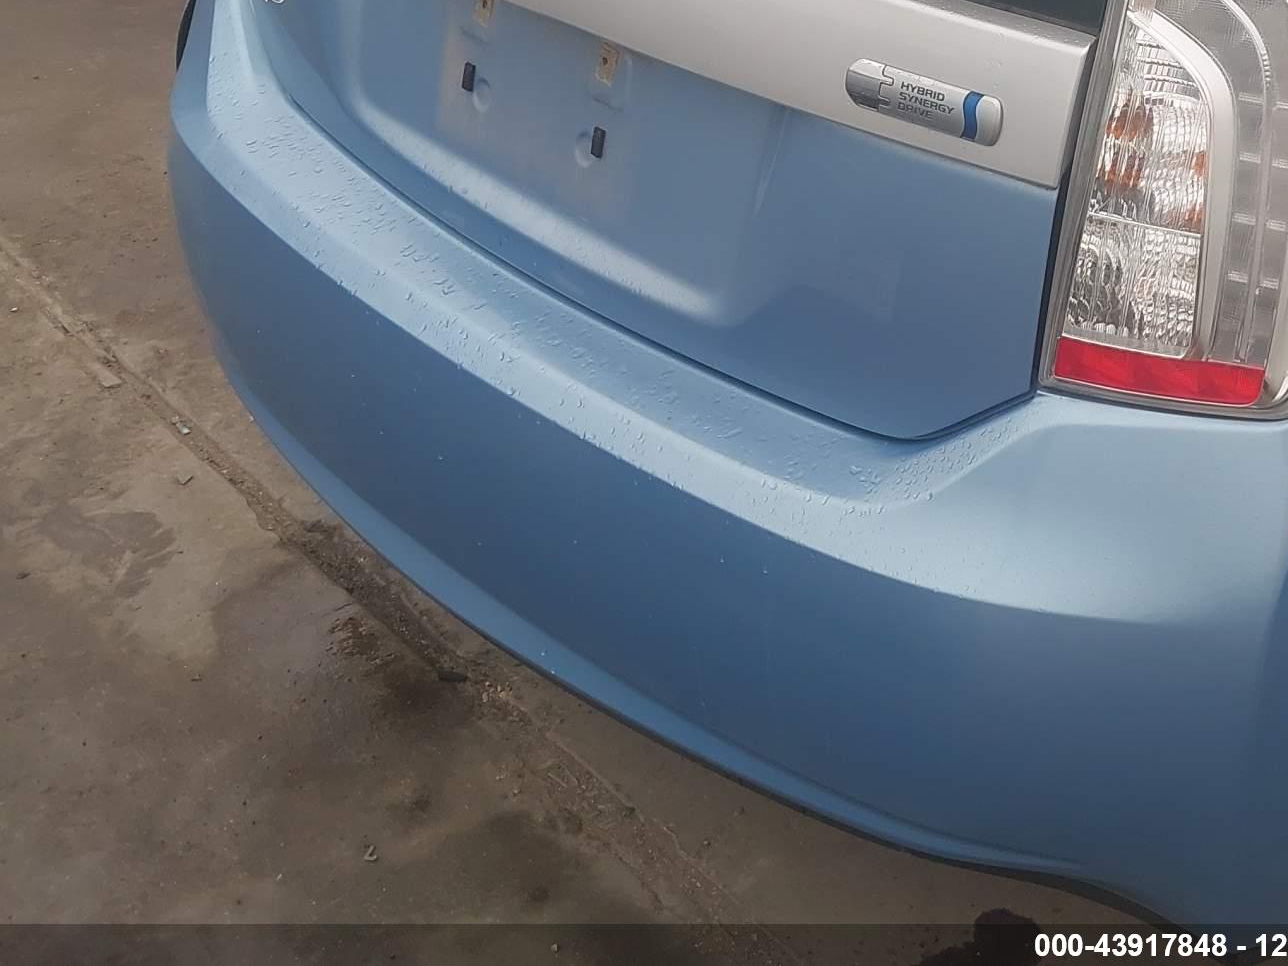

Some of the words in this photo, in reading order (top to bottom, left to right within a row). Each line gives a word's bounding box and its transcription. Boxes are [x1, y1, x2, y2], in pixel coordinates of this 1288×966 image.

[900, 81, 946, 102] HYBRID
[897, 102, 933, 120] DRIVE
[899, 92, 955, 115] SYNERGY
